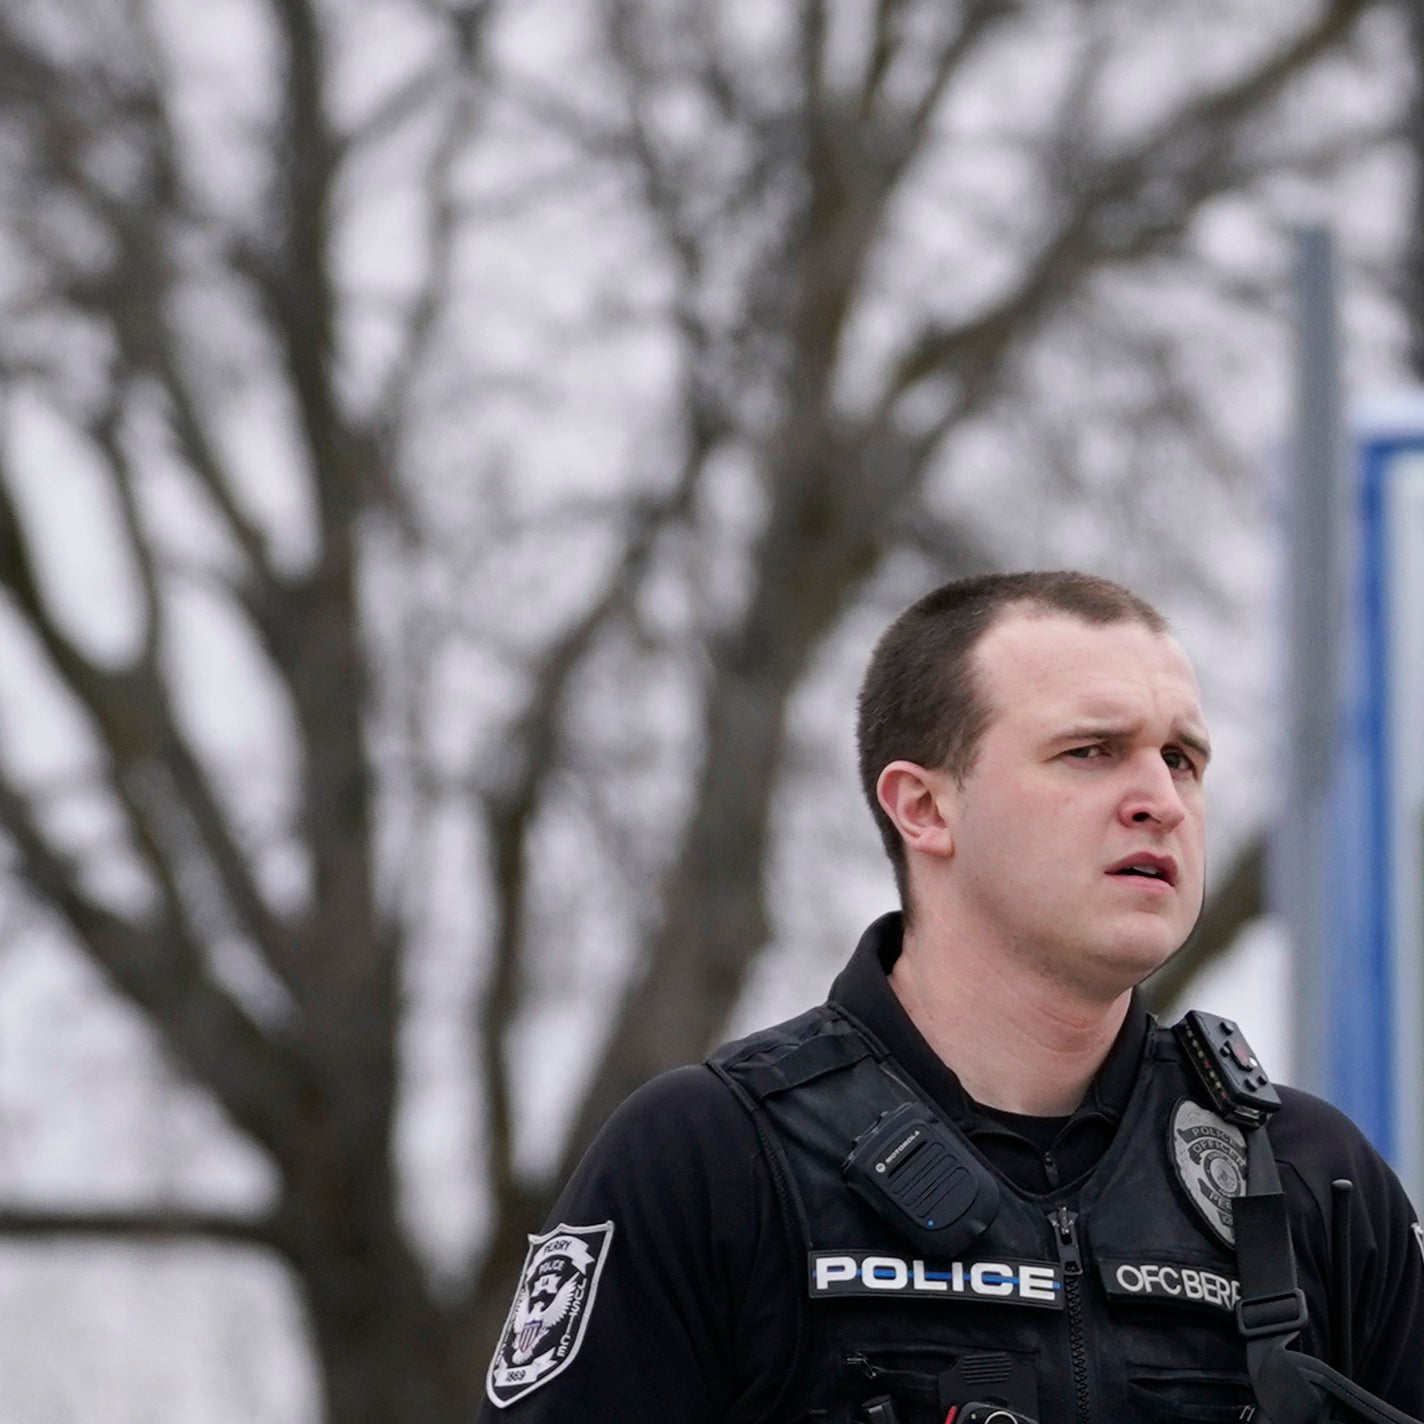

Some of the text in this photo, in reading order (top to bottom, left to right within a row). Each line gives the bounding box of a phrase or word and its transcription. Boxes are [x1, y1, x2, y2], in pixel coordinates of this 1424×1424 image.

[539, 1259, 566, 1275] POLICE
[815, 1256, 1056, 1301] POLICE
[1116, 1264, 1182, 1296] OFC
[556, 1278, 587, 1358] JUSTICE
